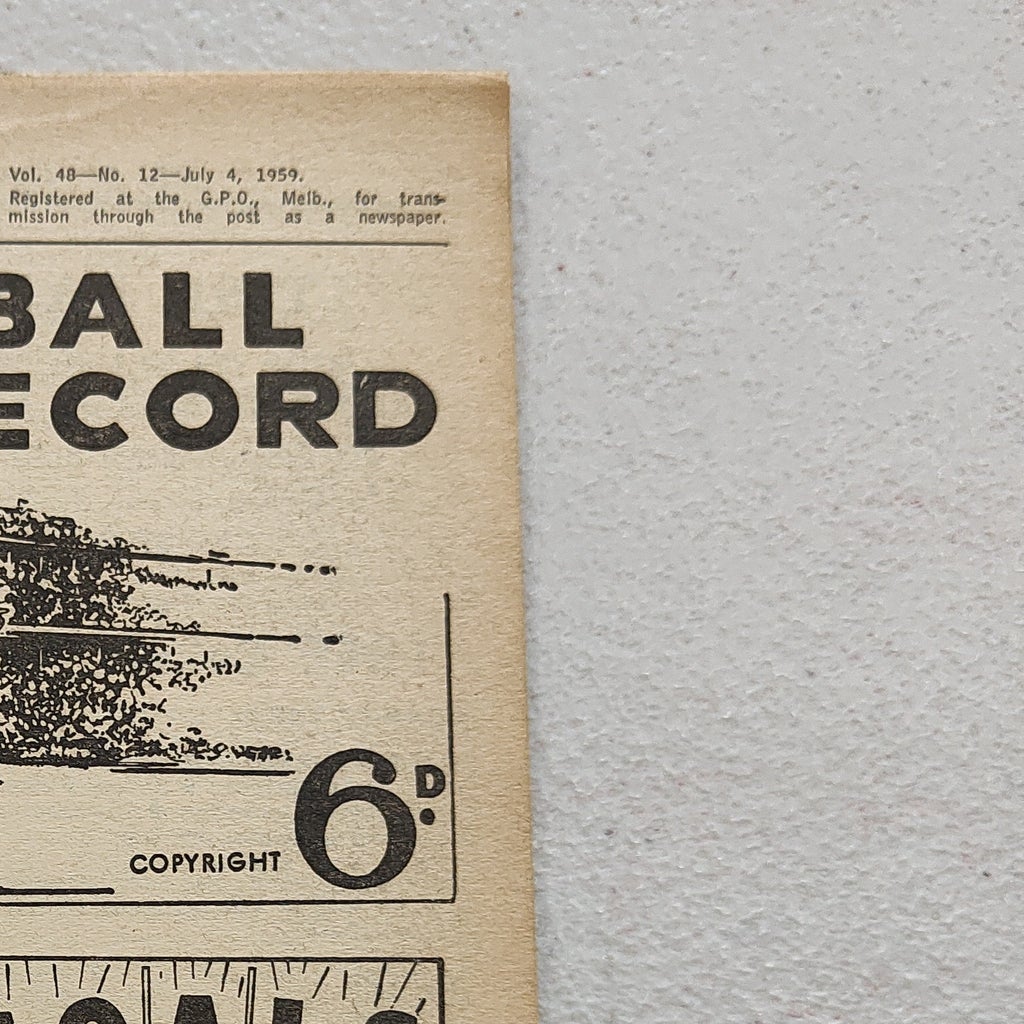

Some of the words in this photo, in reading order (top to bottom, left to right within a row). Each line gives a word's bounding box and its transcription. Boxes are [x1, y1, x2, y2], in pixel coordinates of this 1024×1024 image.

[9, 168, 42, 184] Vol.
[226, 168, 243, 186] 4,
[256, 168, 304, 184] 1959.
[9, 191, 94, 208] Registered
[115, 191, 133, 206] at
[155, 191, 180, 206] the
[201, 191, 259, 208] G.P.O.,
[281, 191, 333, 209] Melb.,
[355, 191, 377, 206] for
[399, 191, 446, 207] trans-
[8, 209, 70, 224] mission
[93, 209, 154, 225] through
[178, 209, 203, 224] the
[226, 209, 260, 226] post
[285, 210, 302, 224] as
[325, 211, 335, 224] a
[358, 210, 446, 226] newspaper.
[128, 850, 282, 876] COPYRIGHT
